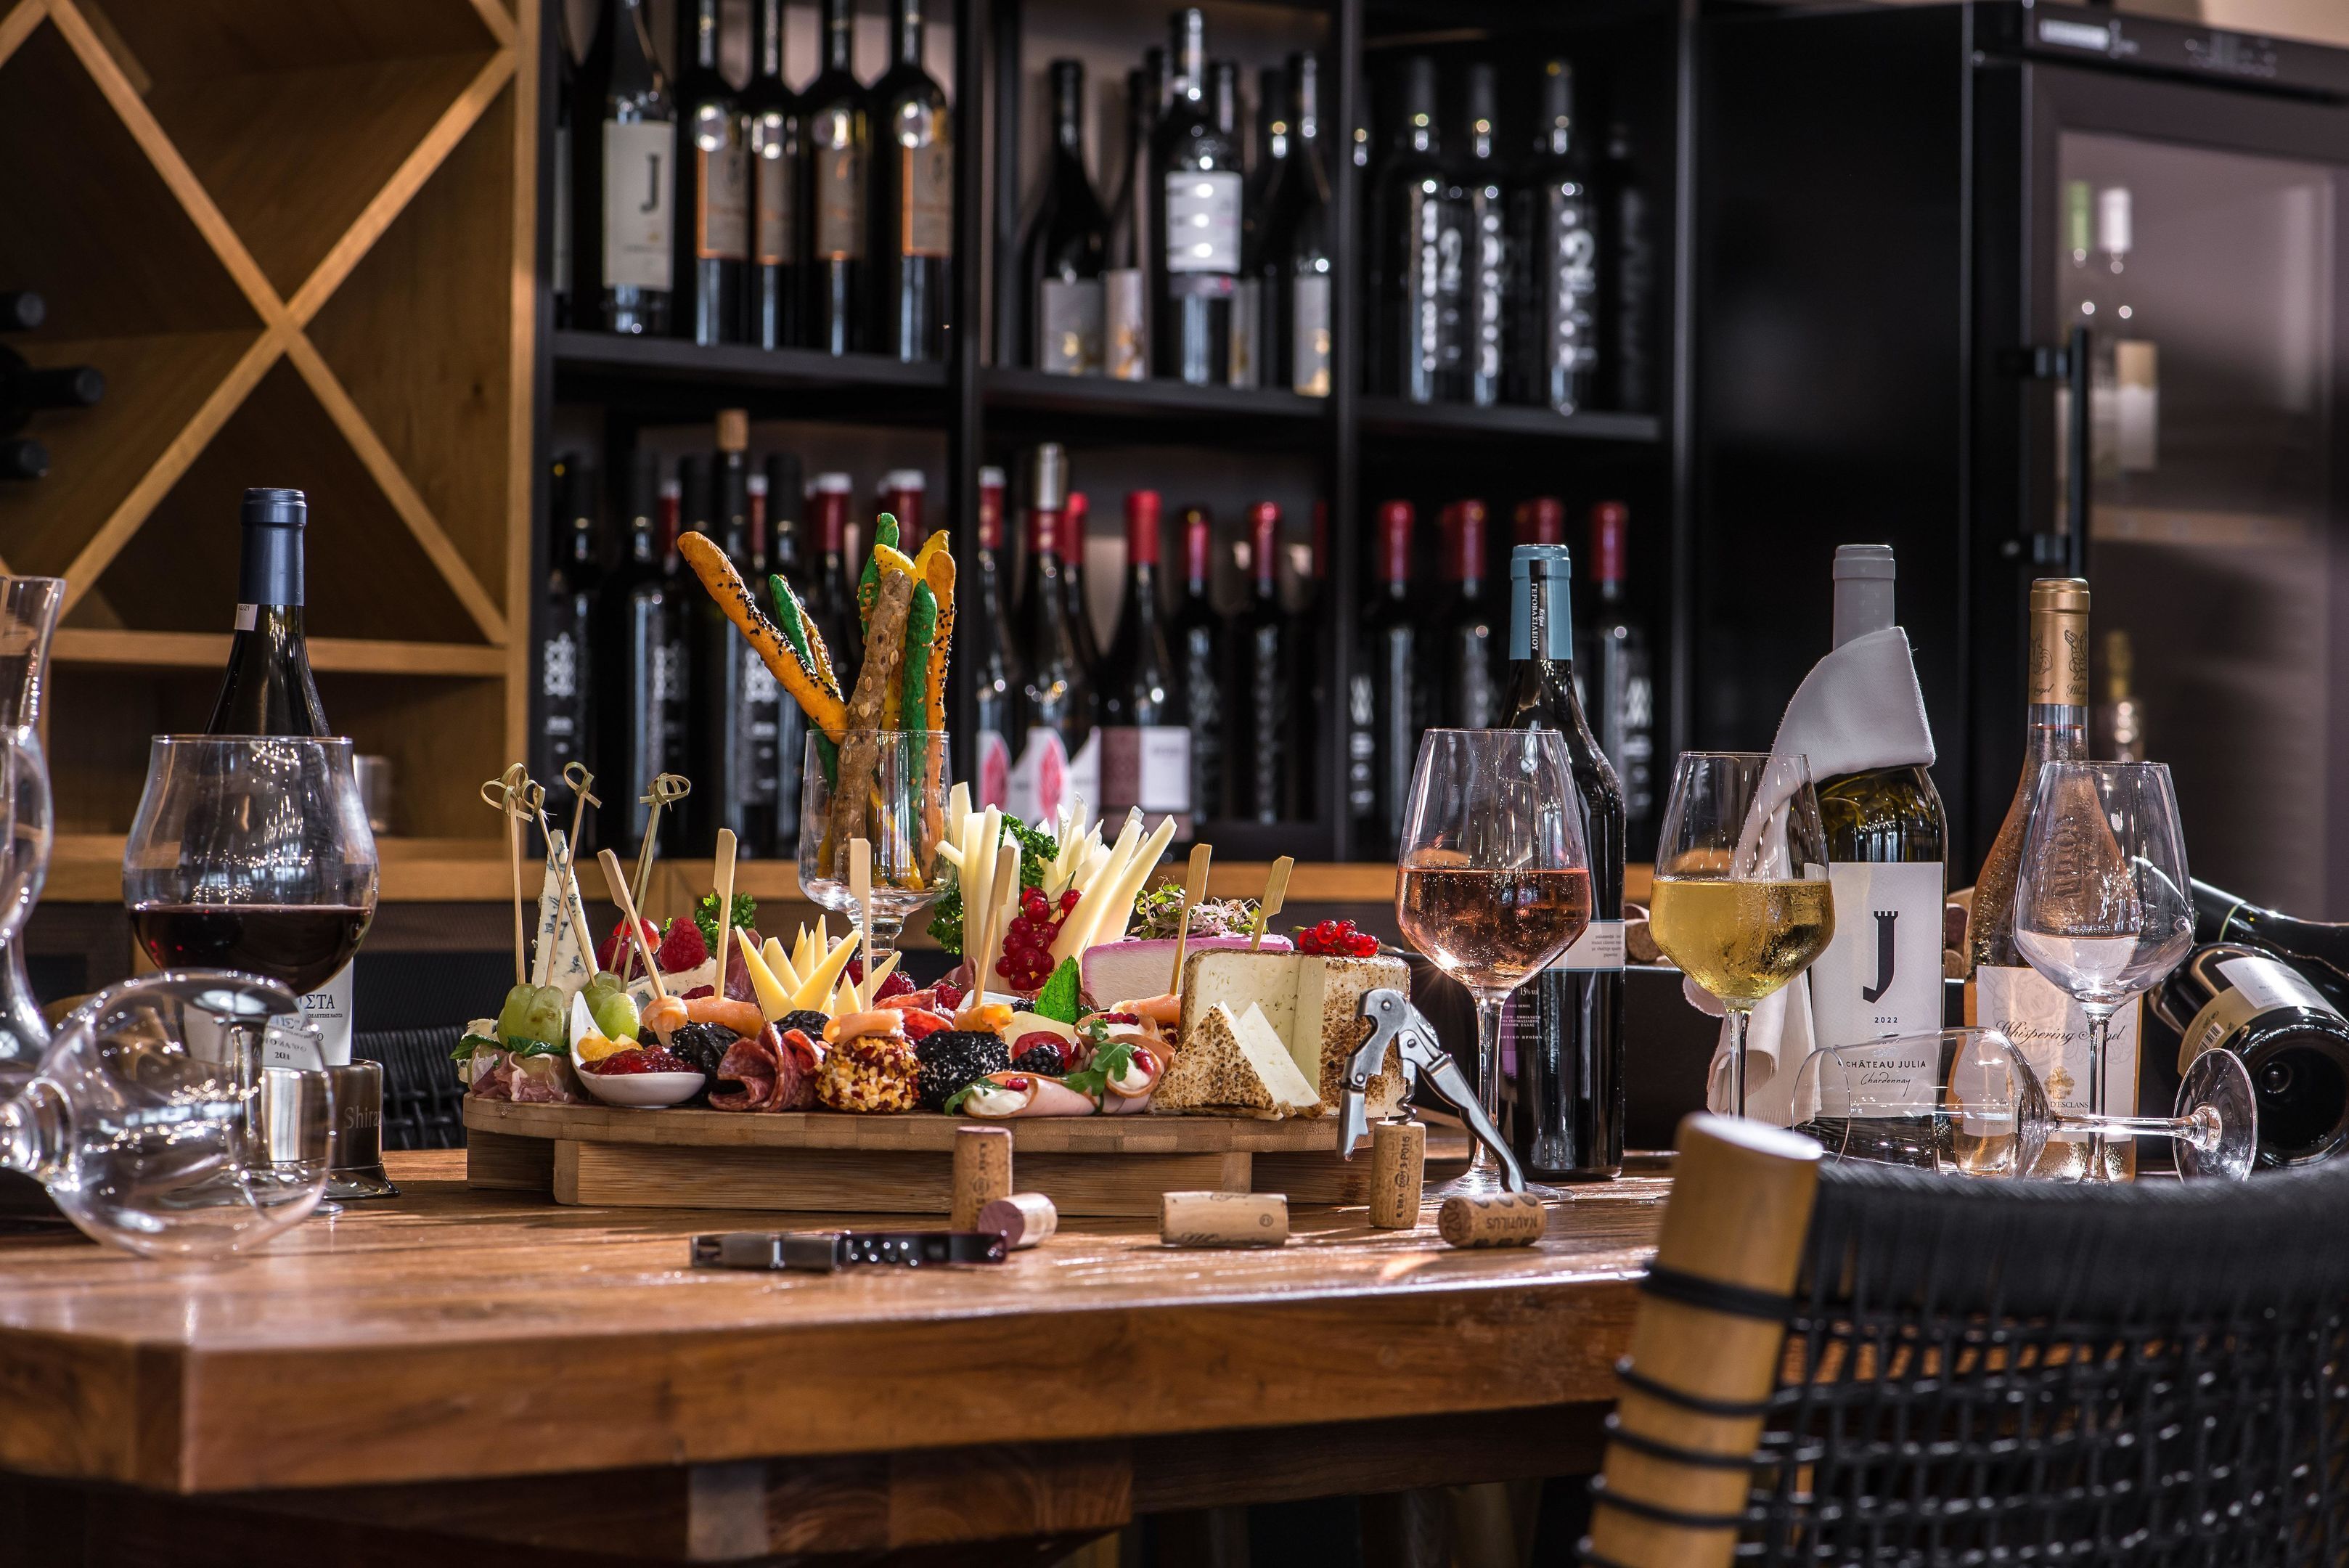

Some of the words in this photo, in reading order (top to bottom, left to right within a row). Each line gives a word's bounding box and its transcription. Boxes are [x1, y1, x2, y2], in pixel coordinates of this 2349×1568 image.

[640, 153, 660, 214] J
[1863, 910, 1899, 1004] J
[1996, 1020, 2075, 1046] Whispering
[1846, 1060, 1895, 1069] CHÂTEAU
[1897, 1060, 1926, 1069] JULIA
[1860, 1071, 1911, 1097] Chardonnay
[1486, 1216, 1538, 1230] NAUTILUS
